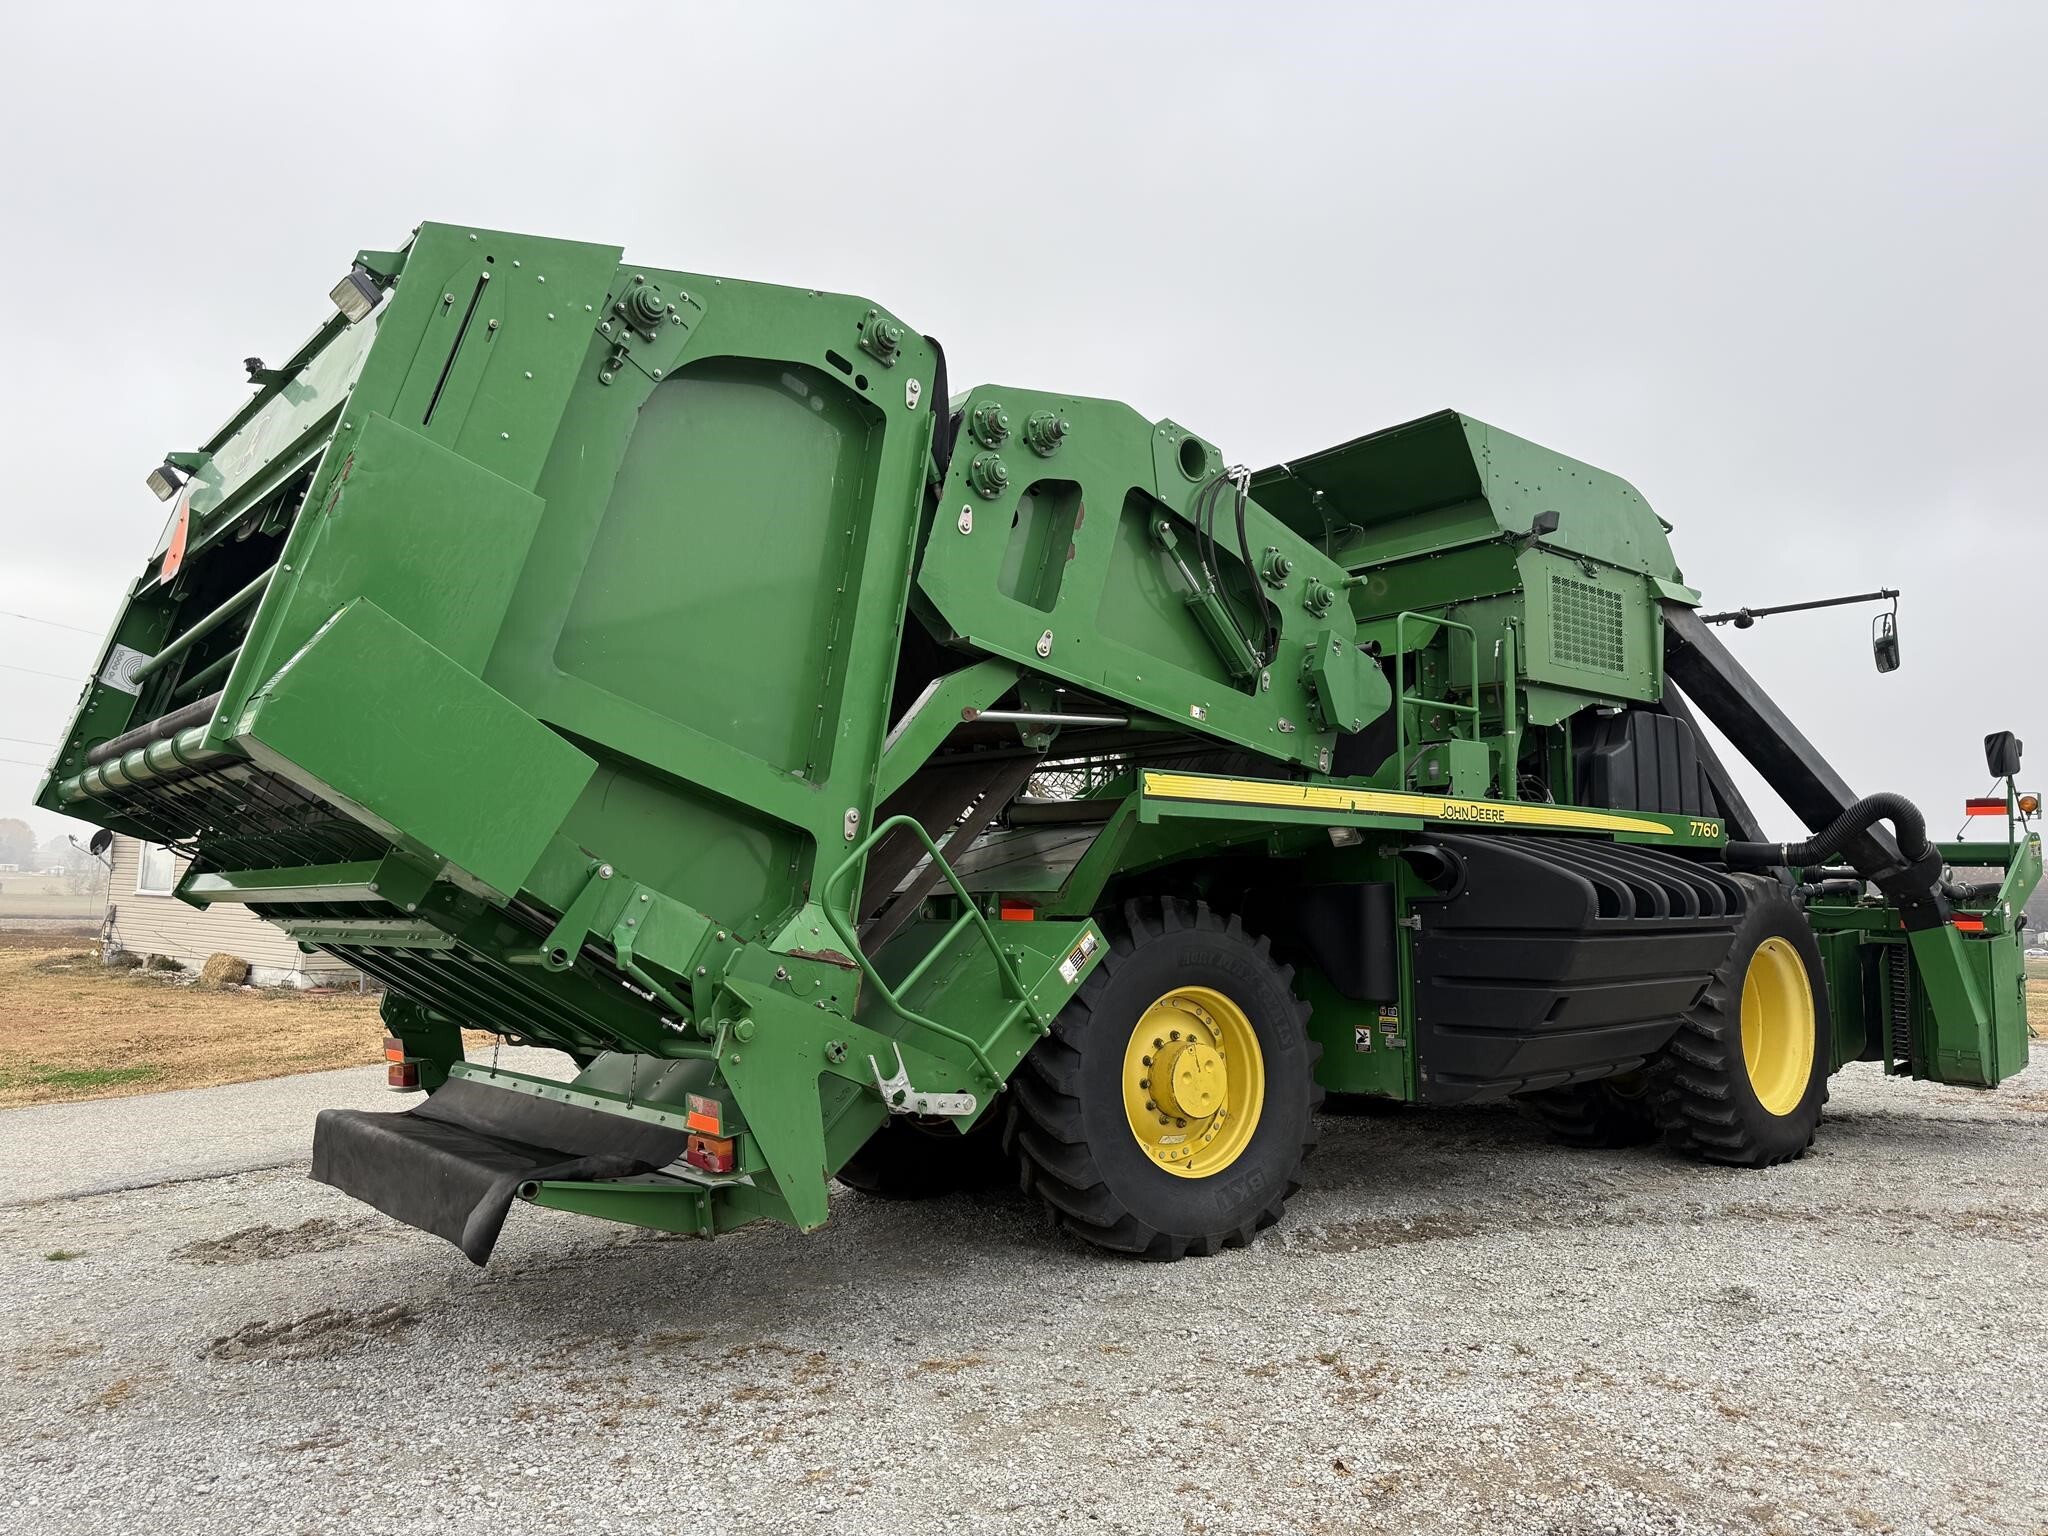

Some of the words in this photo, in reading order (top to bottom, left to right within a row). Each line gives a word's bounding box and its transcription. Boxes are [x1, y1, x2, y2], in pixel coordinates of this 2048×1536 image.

[1440, 802, 1469, 819] JOHN
[1470, 805, 1505, 821] DEERE
[1690, 821, 1719, 838] 7760
